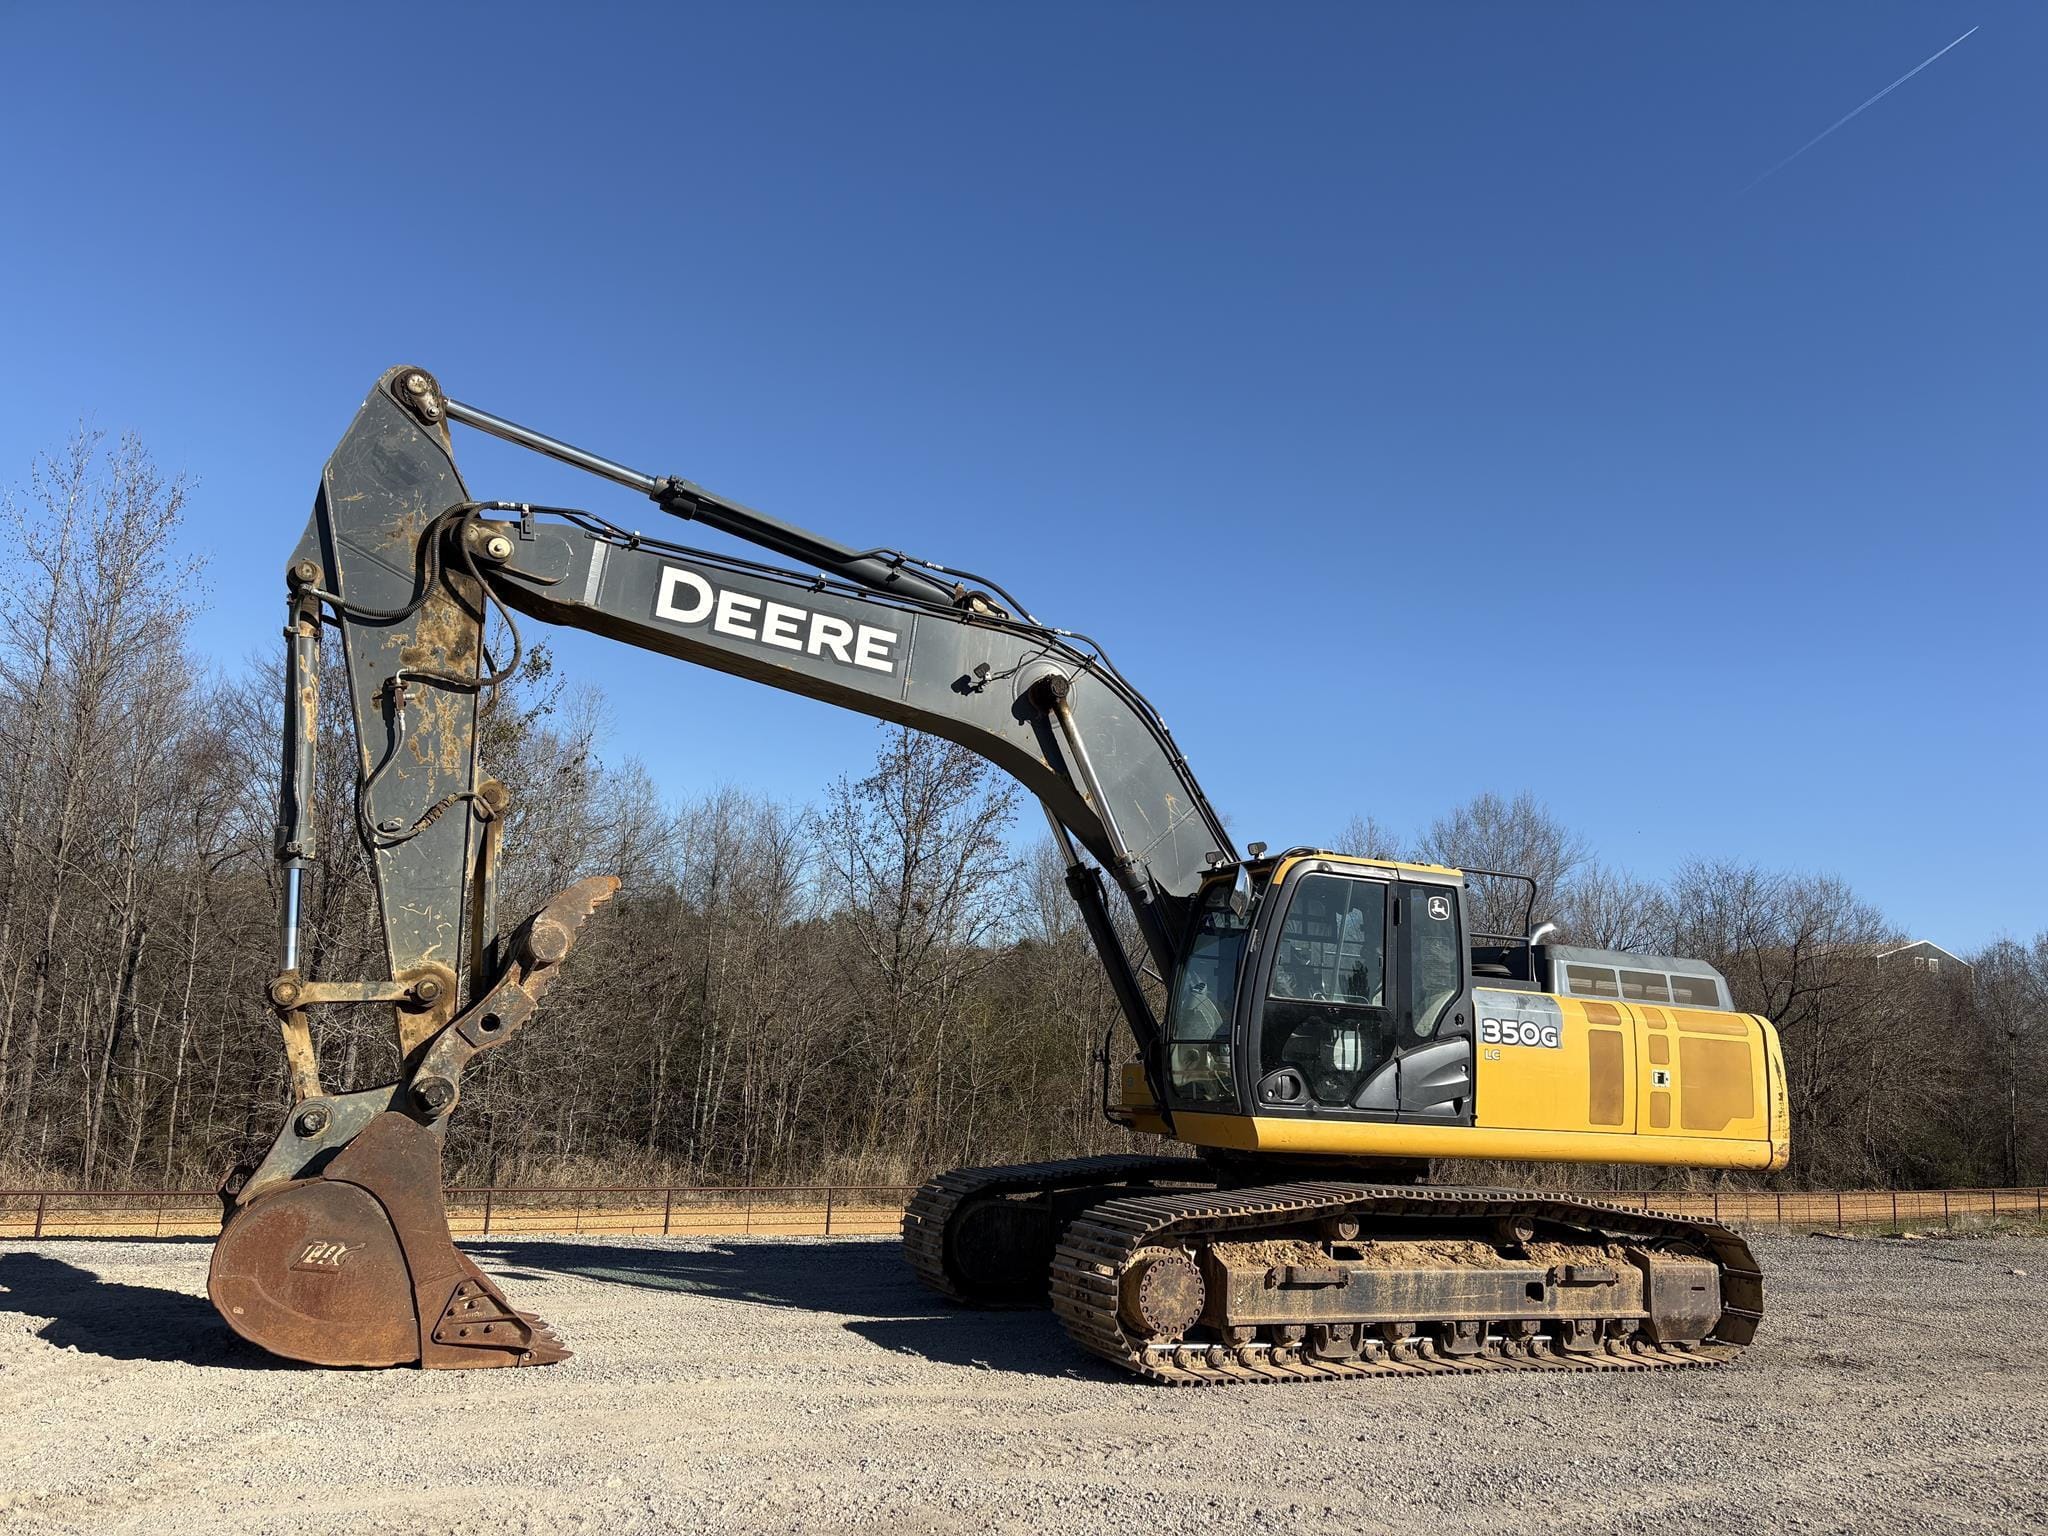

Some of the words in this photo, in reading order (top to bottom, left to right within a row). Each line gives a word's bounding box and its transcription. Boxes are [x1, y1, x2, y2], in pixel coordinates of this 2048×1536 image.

[655, 565, 898, 673] DEERE
[1482, 1018, 1559, 1048] 350G
[1485, 1049, 1500, 1060] LC
